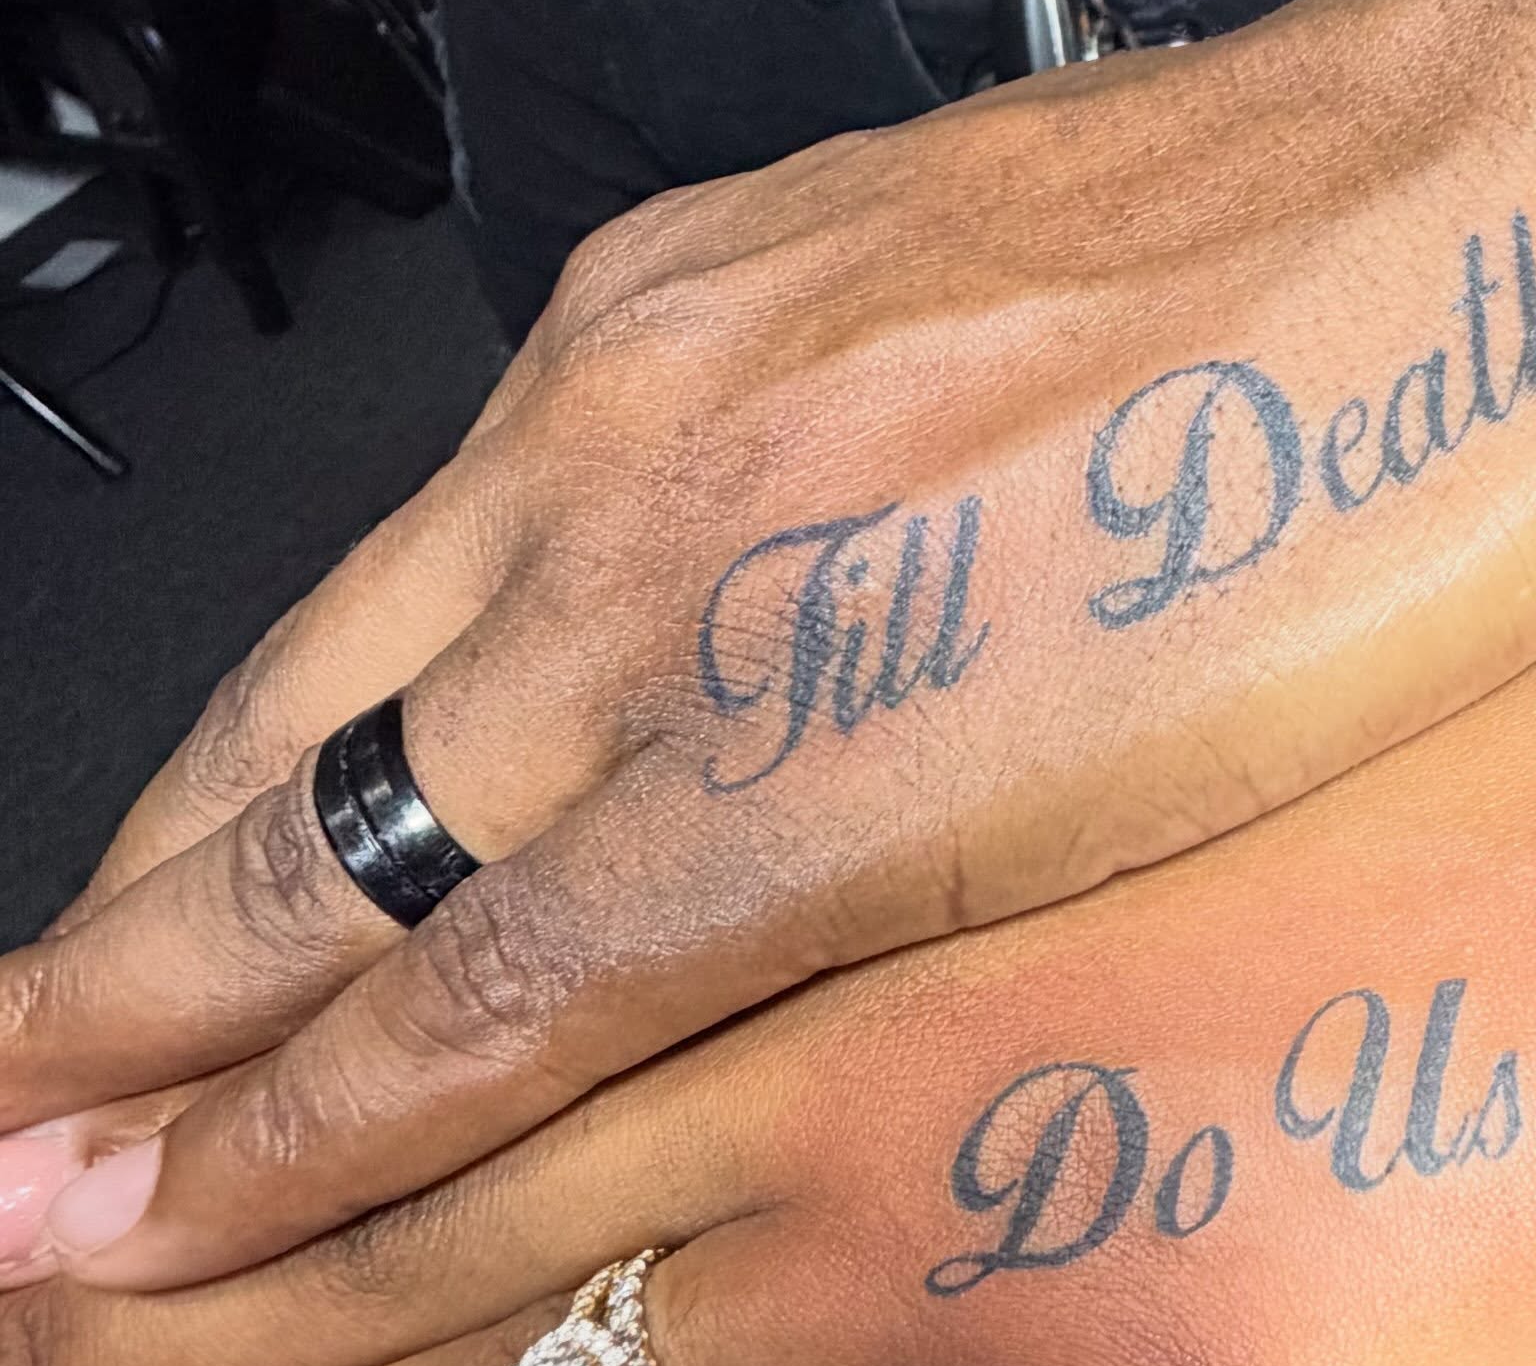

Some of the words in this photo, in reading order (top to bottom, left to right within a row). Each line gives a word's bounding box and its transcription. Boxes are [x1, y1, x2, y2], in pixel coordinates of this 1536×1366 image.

[699, 494, 991, 795] Till
[924, 1061, 1235, 1297] Do
[1274, 978, 1525, 1193] Us
